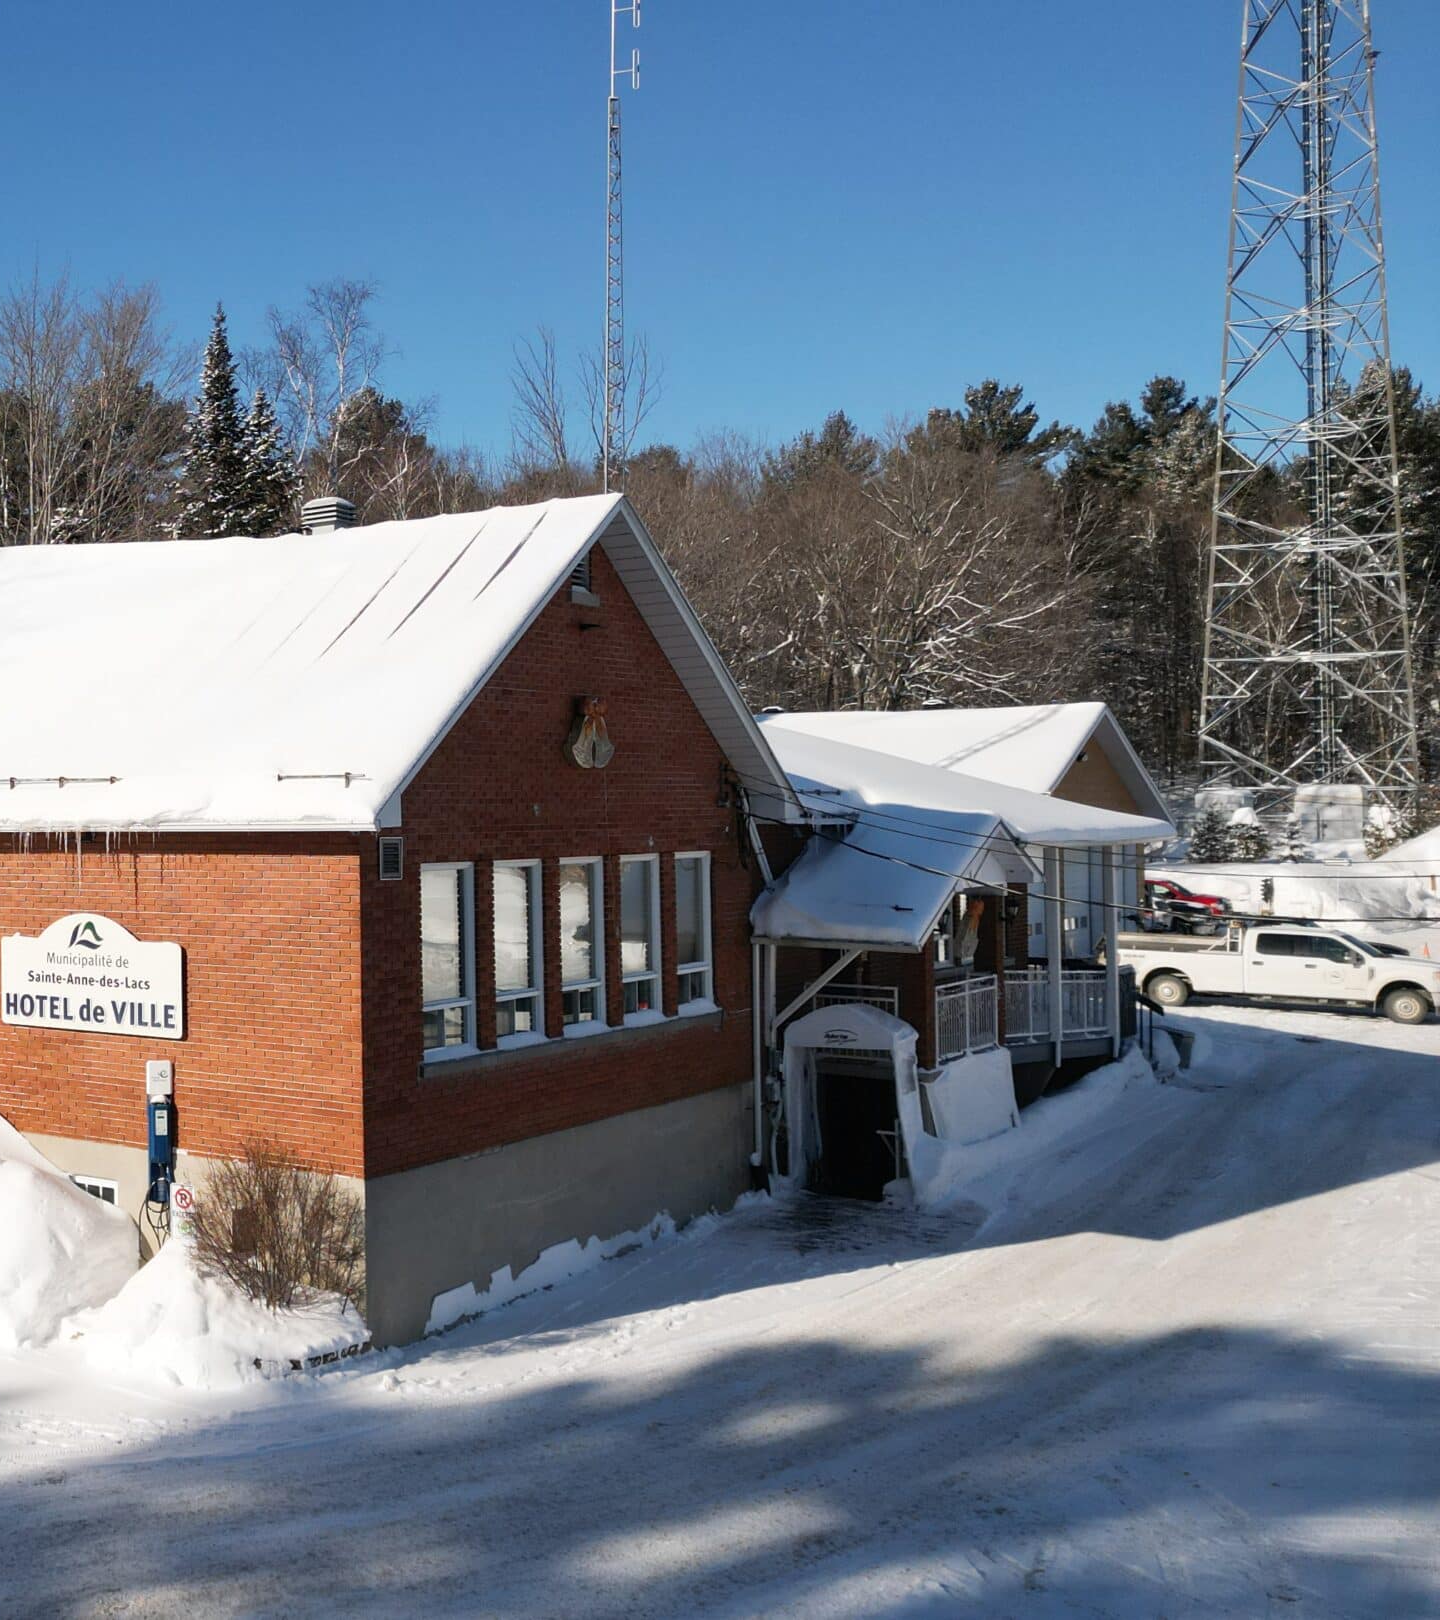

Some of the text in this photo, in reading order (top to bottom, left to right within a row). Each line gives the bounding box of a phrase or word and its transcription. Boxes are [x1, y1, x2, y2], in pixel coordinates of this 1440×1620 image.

[46, 951, 129, 969] Municipalité de
[27, 969, 151, 990] Sainte-Anne-des-Lacs
[5, 992, 176, 1029] HOTEL de VILLE
